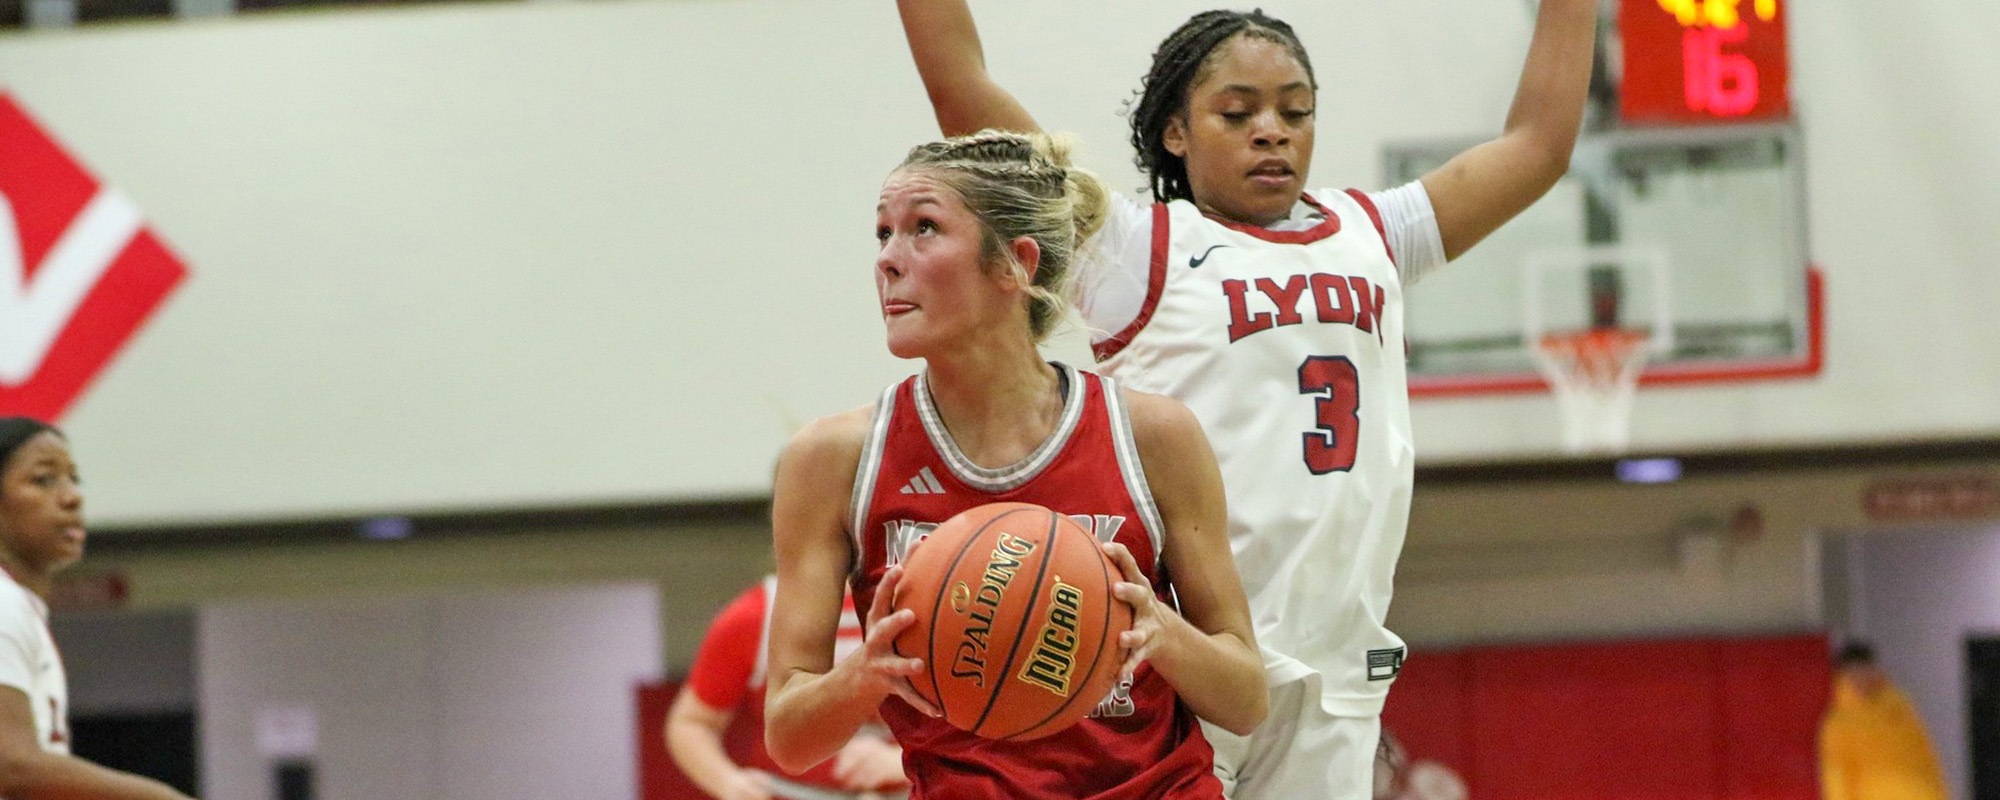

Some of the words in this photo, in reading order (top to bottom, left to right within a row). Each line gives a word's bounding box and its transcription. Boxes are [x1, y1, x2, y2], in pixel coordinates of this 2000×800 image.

[1683, 22, 1759, 117] 16
[1221, 272, 1386, 349] LYON
[1297, 354, 1360, 476] 3
[951, 532, 1037, 688] SPALDING
[1018, 582, 1084, 697] NJCAA
